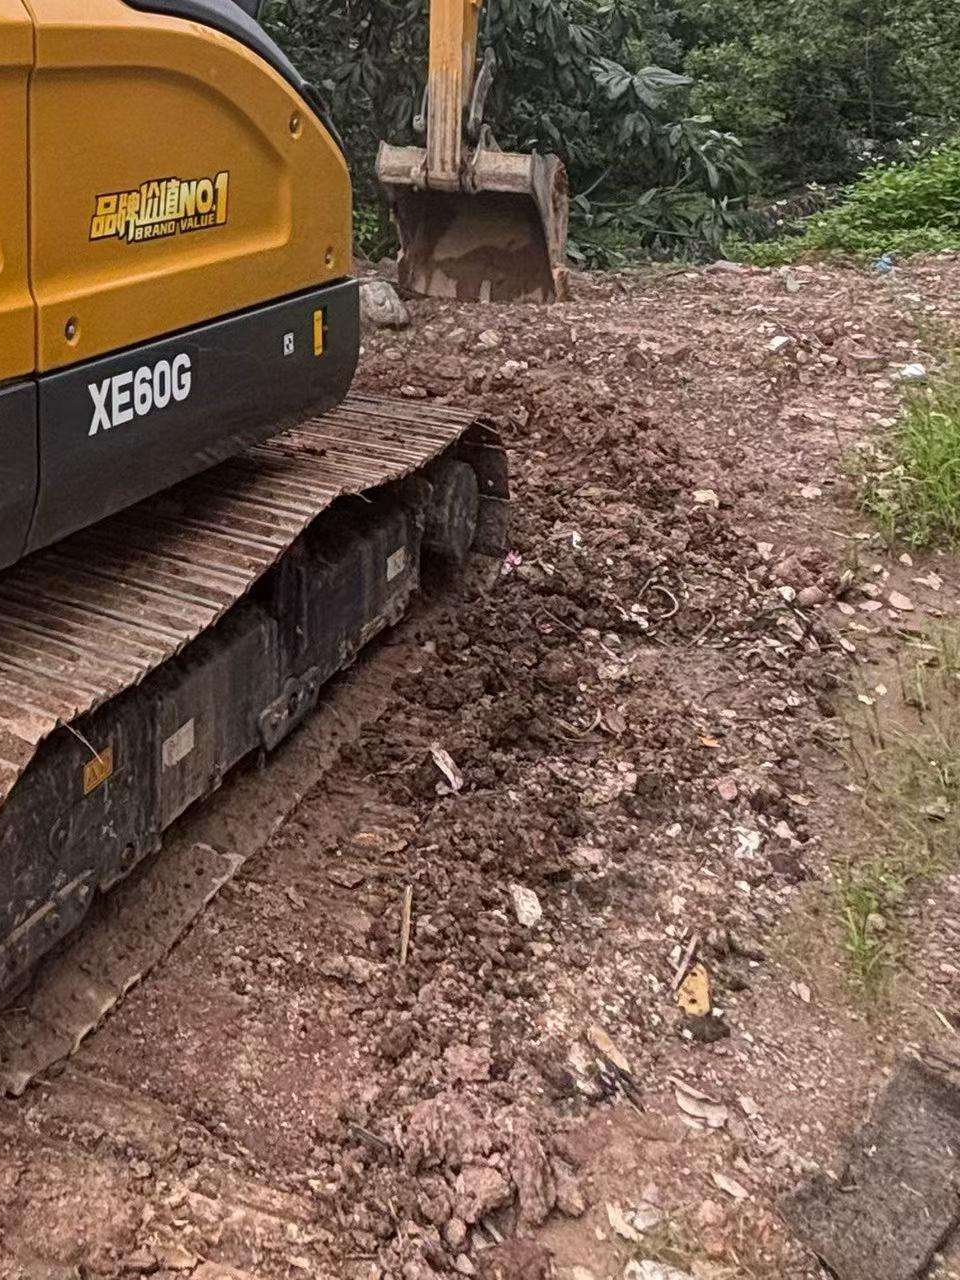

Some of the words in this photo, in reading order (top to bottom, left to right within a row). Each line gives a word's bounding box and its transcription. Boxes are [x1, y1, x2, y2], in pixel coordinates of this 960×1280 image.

[134, 220, 176, 241] BRAND
[179, 212, 216, 231] VALUE
[87, 352, 192, 437] XE60G
